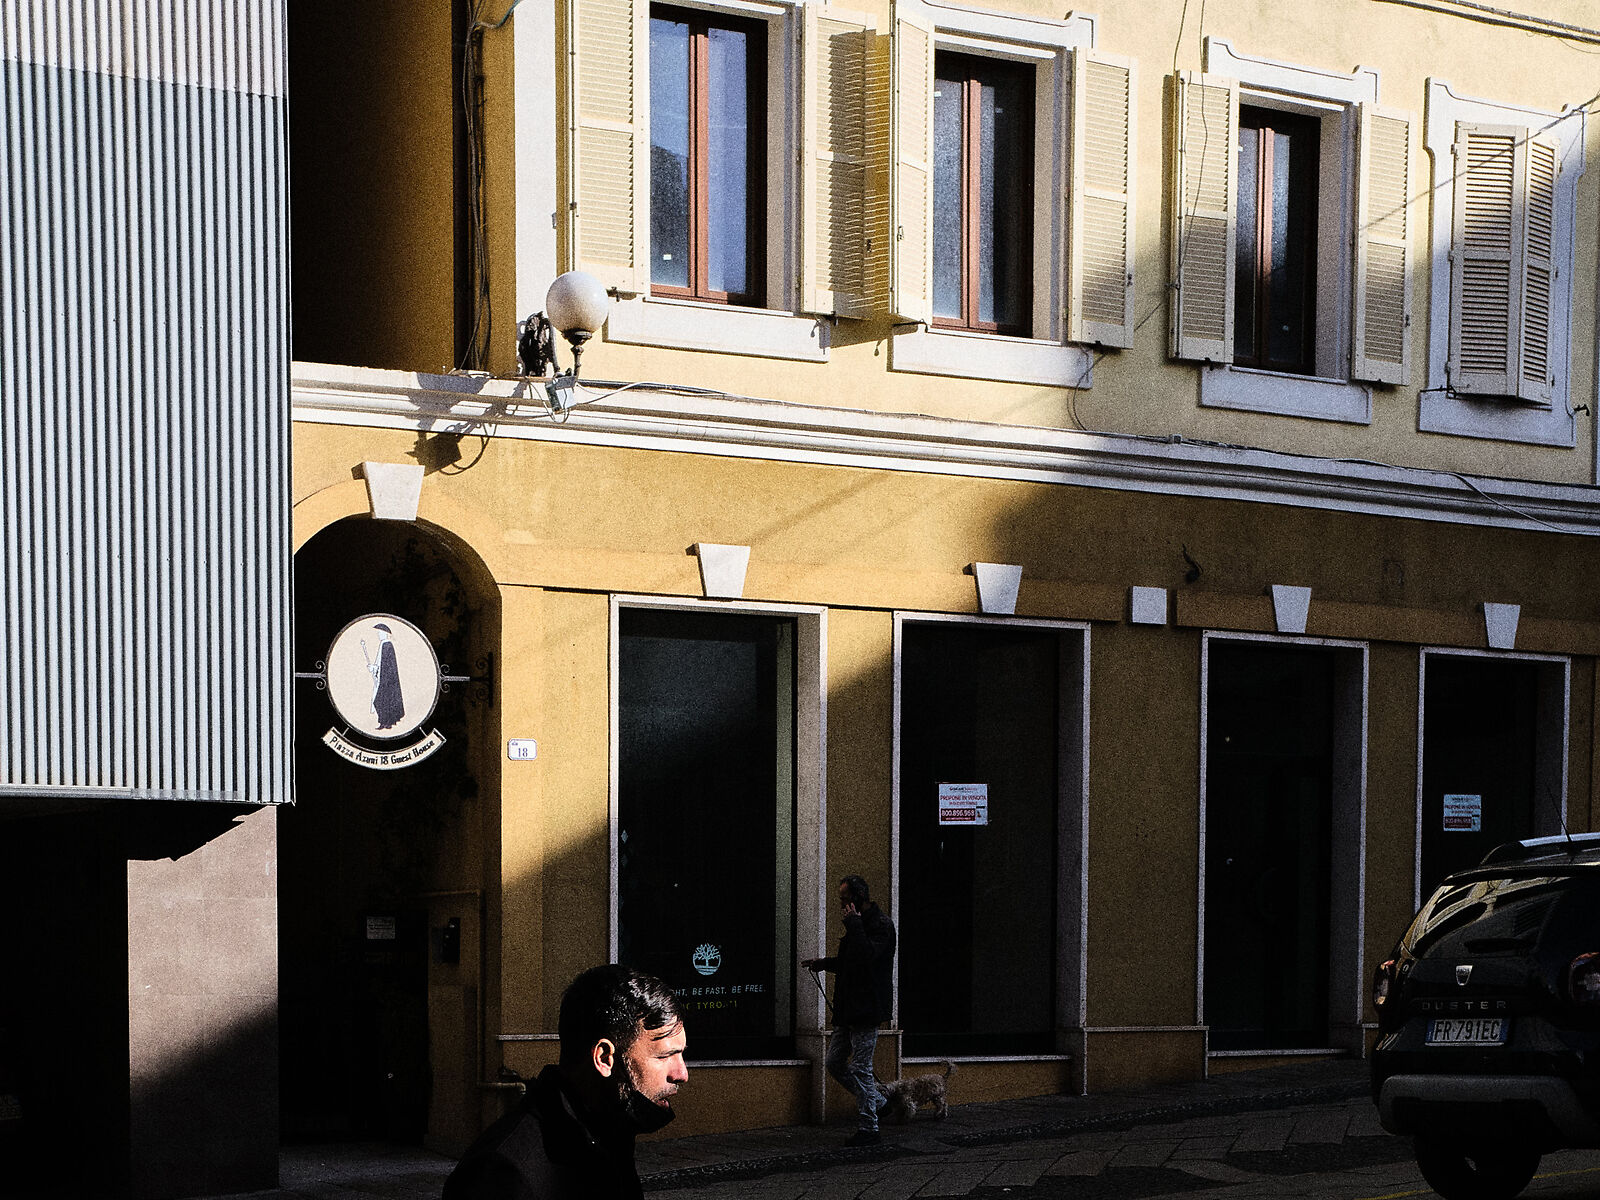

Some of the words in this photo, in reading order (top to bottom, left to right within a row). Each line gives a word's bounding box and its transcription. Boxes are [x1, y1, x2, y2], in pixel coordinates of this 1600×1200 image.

[329, 736, 353, 758] Piazza
[380, 755, 389, 765] 18
[391, 753, 411, 765] Guest
[413, 740, 435, 758] House
[518, 747, 528, 758] 18
[692, 987, 703, 996] BE
[705, 986, 727, 995] FAST.
[731, 985, 742, 994] BE
[744, 984, 767, 993] FREE.
[1422, 1000, 1507, 1010] DUSTER
